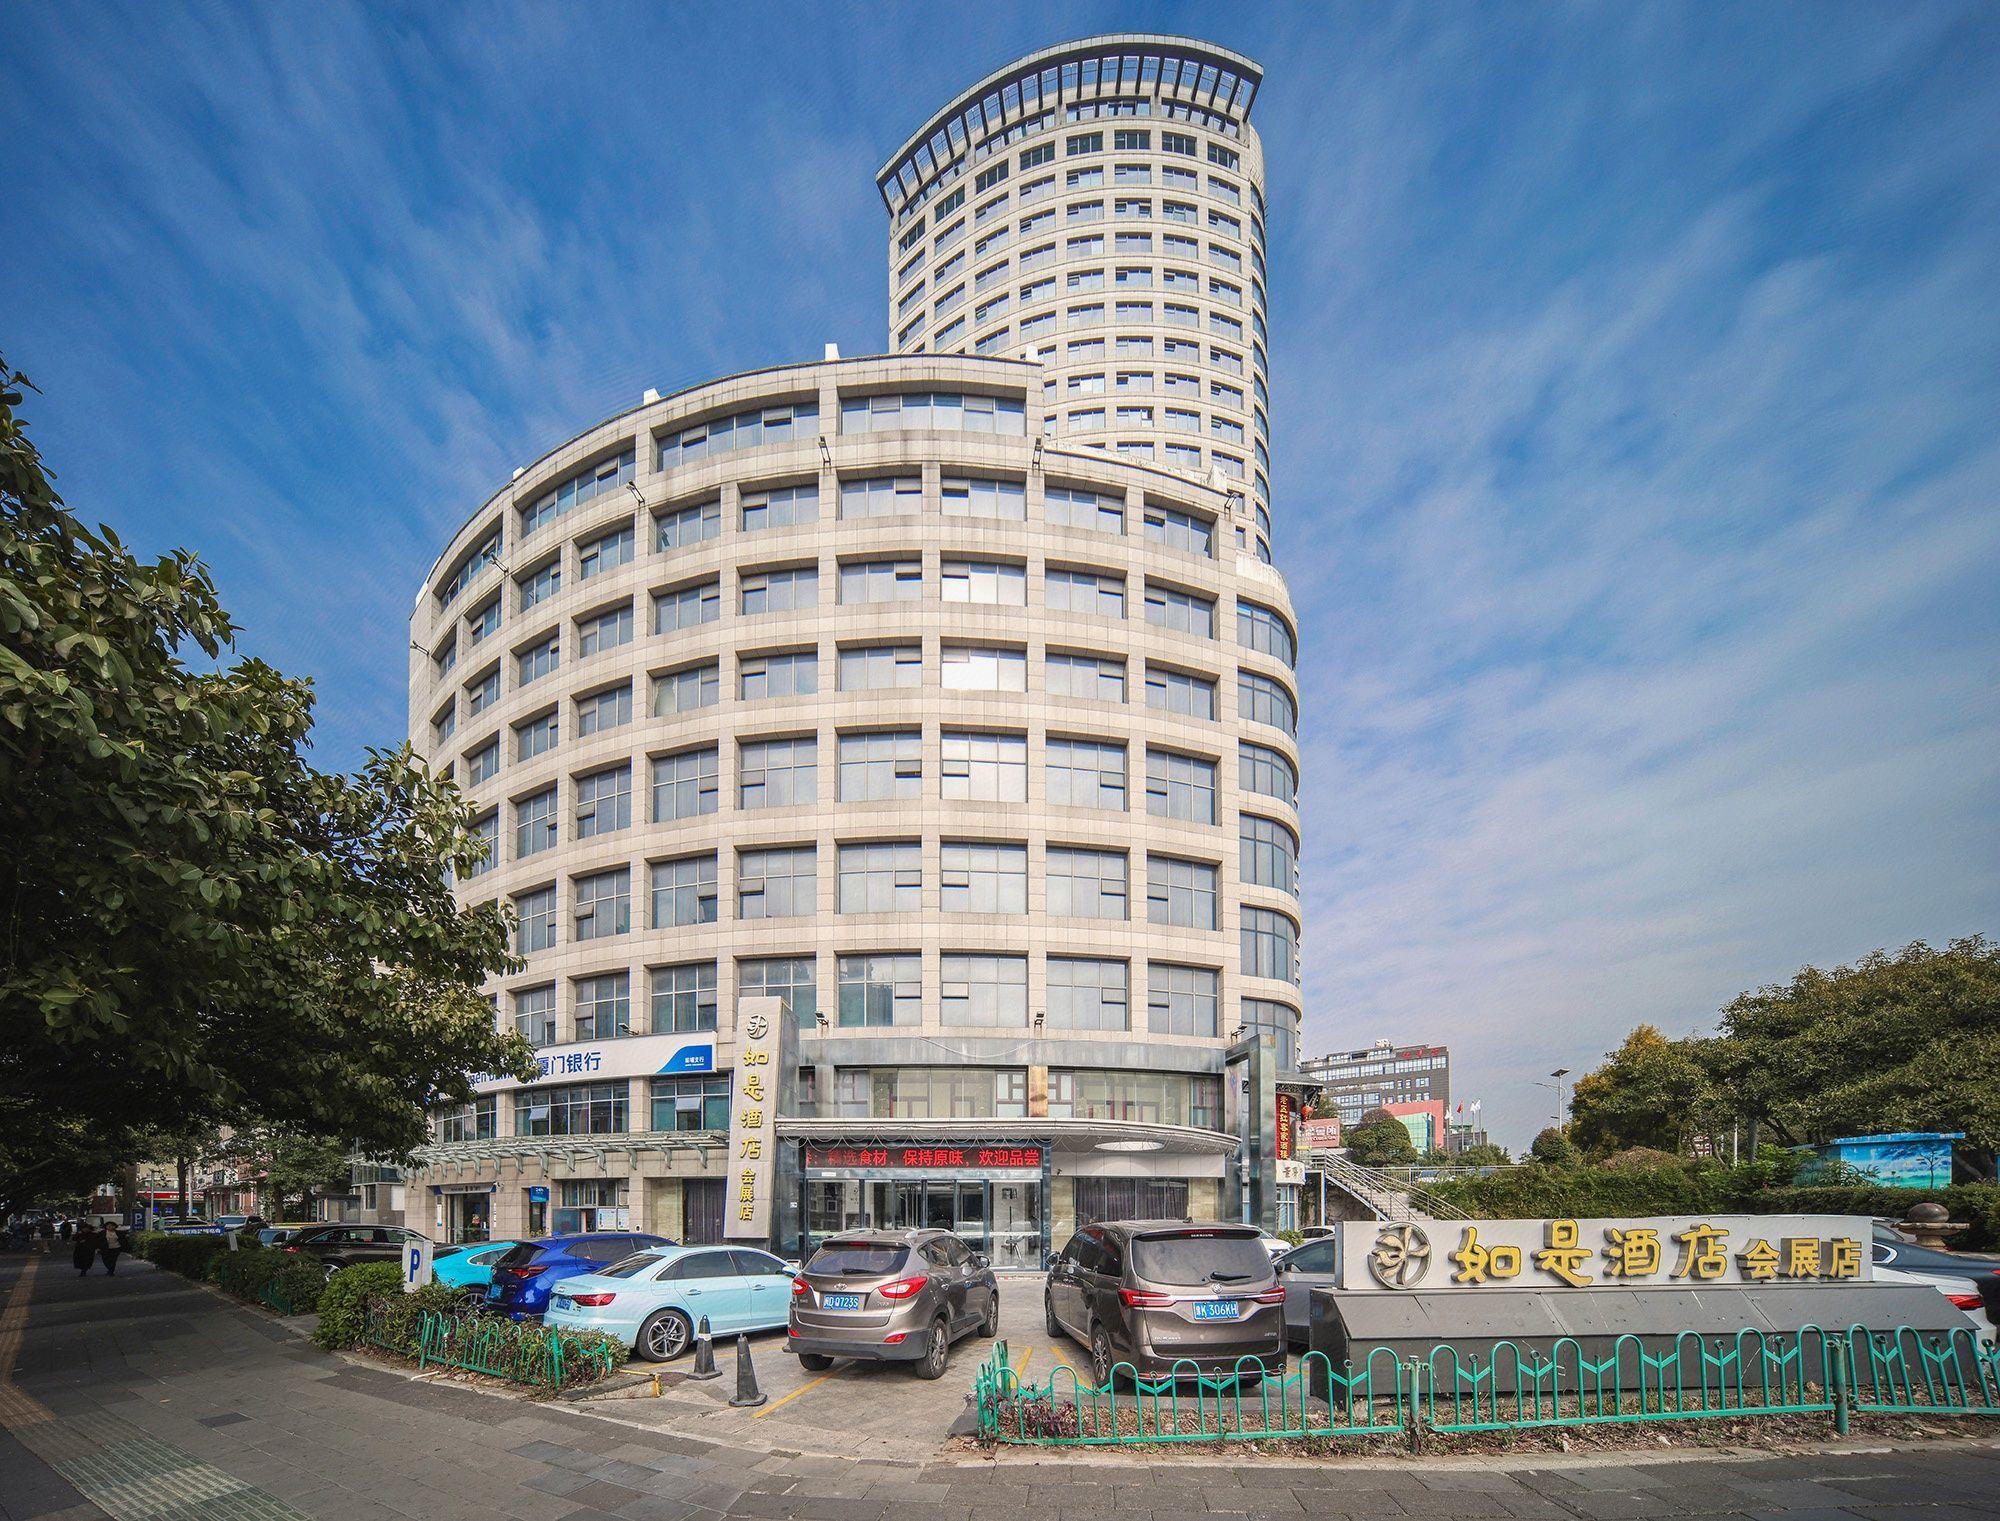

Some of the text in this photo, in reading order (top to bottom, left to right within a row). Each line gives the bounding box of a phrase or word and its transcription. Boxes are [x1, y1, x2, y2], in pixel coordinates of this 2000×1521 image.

[536, 1052, 602, 1077] 厦门银行
[134, 1213, 143, 1225] P
[409, 1248, 420, 1282] P
